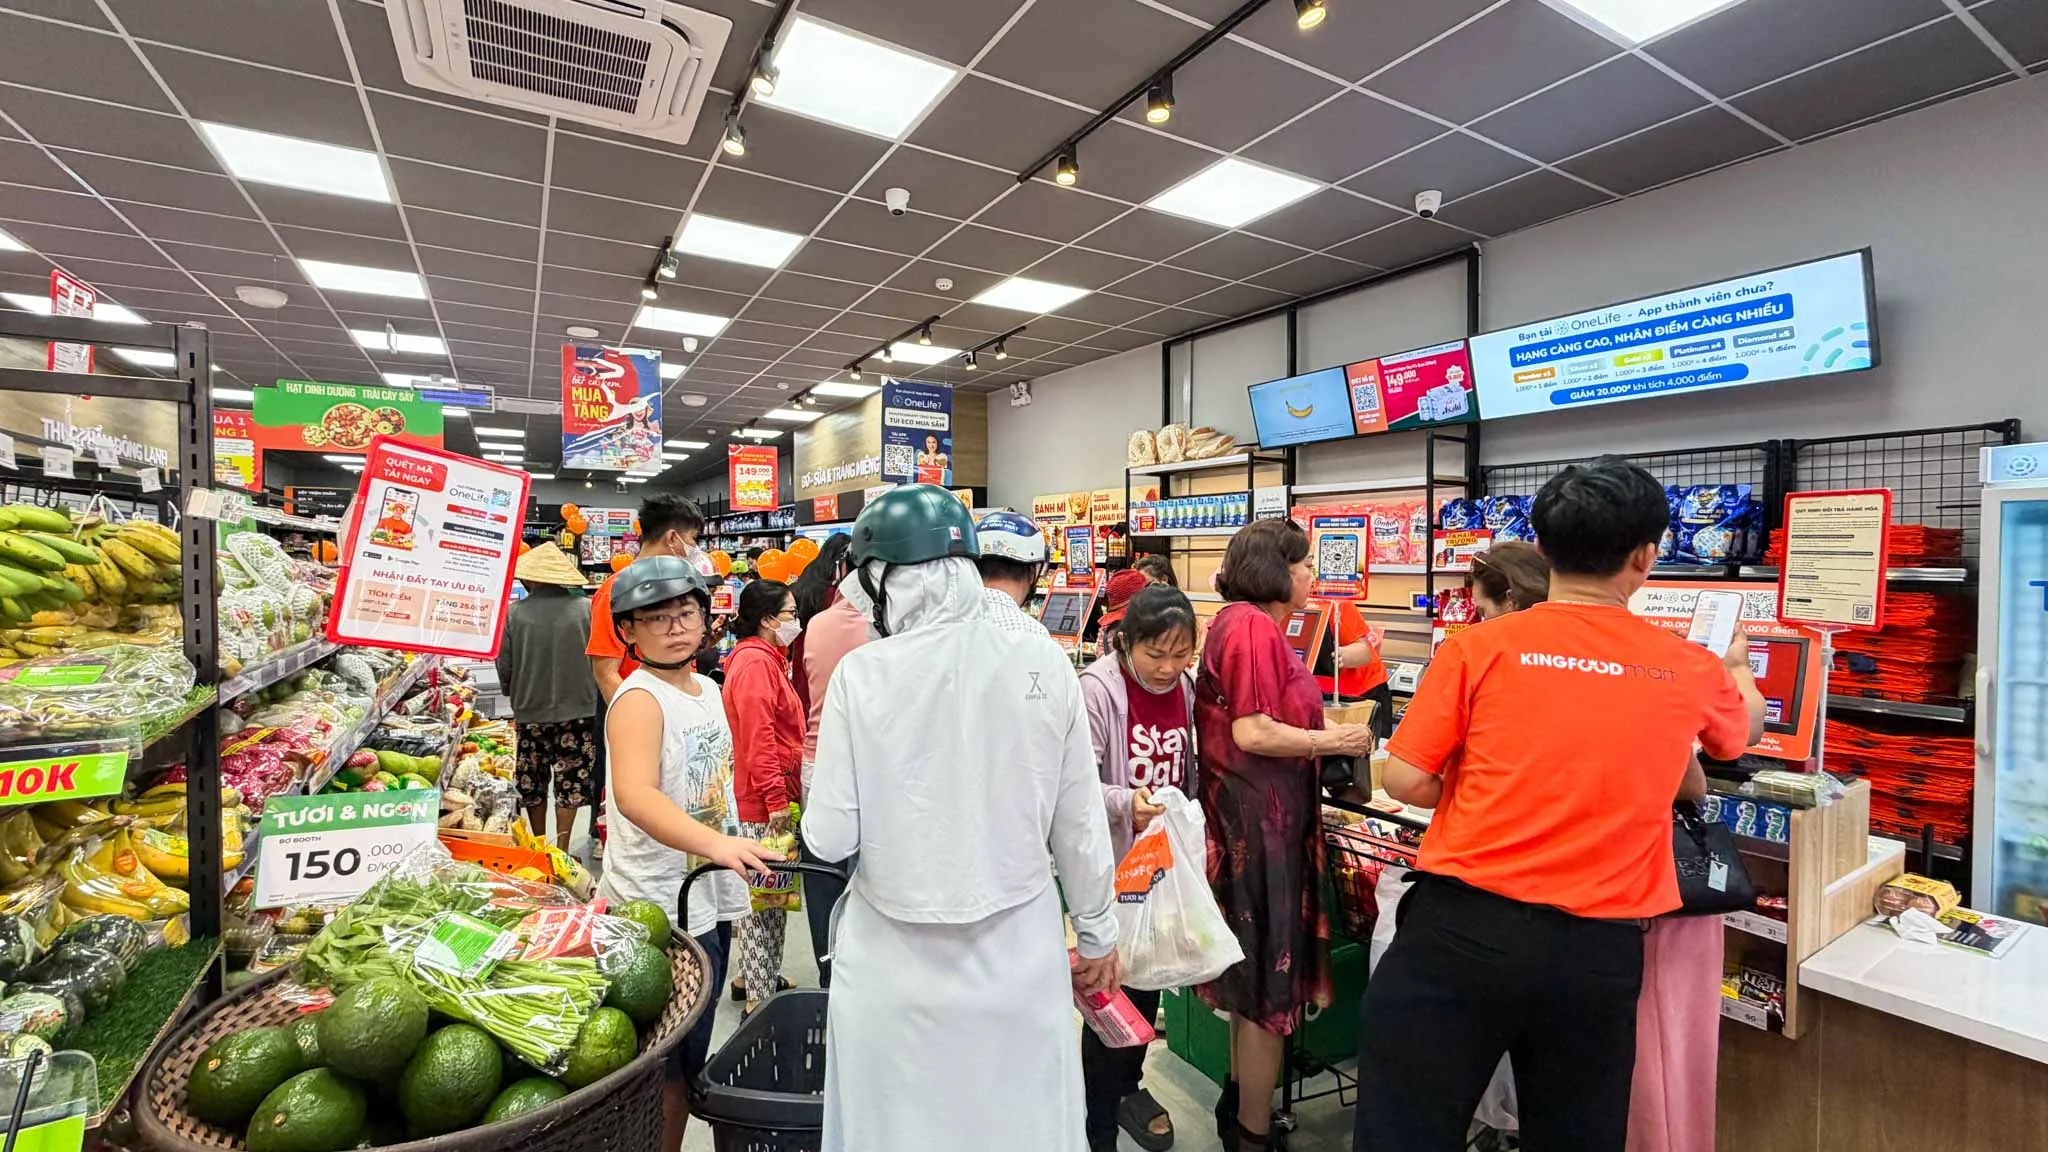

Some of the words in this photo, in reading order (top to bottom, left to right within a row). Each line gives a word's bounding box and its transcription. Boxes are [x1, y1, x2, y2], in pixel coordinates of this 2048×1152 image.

[1518, 331, 1537, 342] Bạn
[1571, 312, 1621, 331] OneLife
[1638, 303, 1662, 318] App
[1665, 296, 1702, 313] thành
[1704, 291, 1731, 304] viên
[1735, 281, 1774, 297] chưa?
[1516, 345, 1549, 364] HẠNG
[1550, 337, 1582, 356] CÀNG
[1584, 335, 1613, 349] CAO,
[1615, 327, 1652, 345] NHÂN
[1654, 319, 1689, 336] ĐIỂM
[1691, 313, 1733, 330] CÀNG
[1735, 301, 1784, 322] NHIỀU
[1737, 332, 1777, 344] Diamond
[1674, 343, 1710, 356] Platinum
[1570, 387, 1595, 400] GIẢM
[1633, 381, 1647, 391] khi
[1648, 378, 1665, 390] tích
[1667, 374, 1695, 386] 4,000
[1697, 371, 1722, 382] điểm
[571, 386, 602, 403] MUA
[572, 401, 609, 421] TẶNG
[904, 397, 942, 410] OneLife?
[213, 414, 234, 425] UA
[215, 427, 237, 437] NG
[385, 457, 414, 473] QUÉT
[416, 463, 433, 475] MÃ
[402, 472, 432, 486] NGAY
[449, 487, 490, 504] OneLife
[430, 578, 449, 588] TAY
[1644, 605, 1666, 613] APP
[1666, 604, 1694, 614] THÀN
[272, 803, 334, 829] TƯƠI
[339, 805, 358, 820] &
[293, 834, 322, 844] BOOTH
[285, 847, 362, 882] 150
[367, 843, 404, 858] .000
